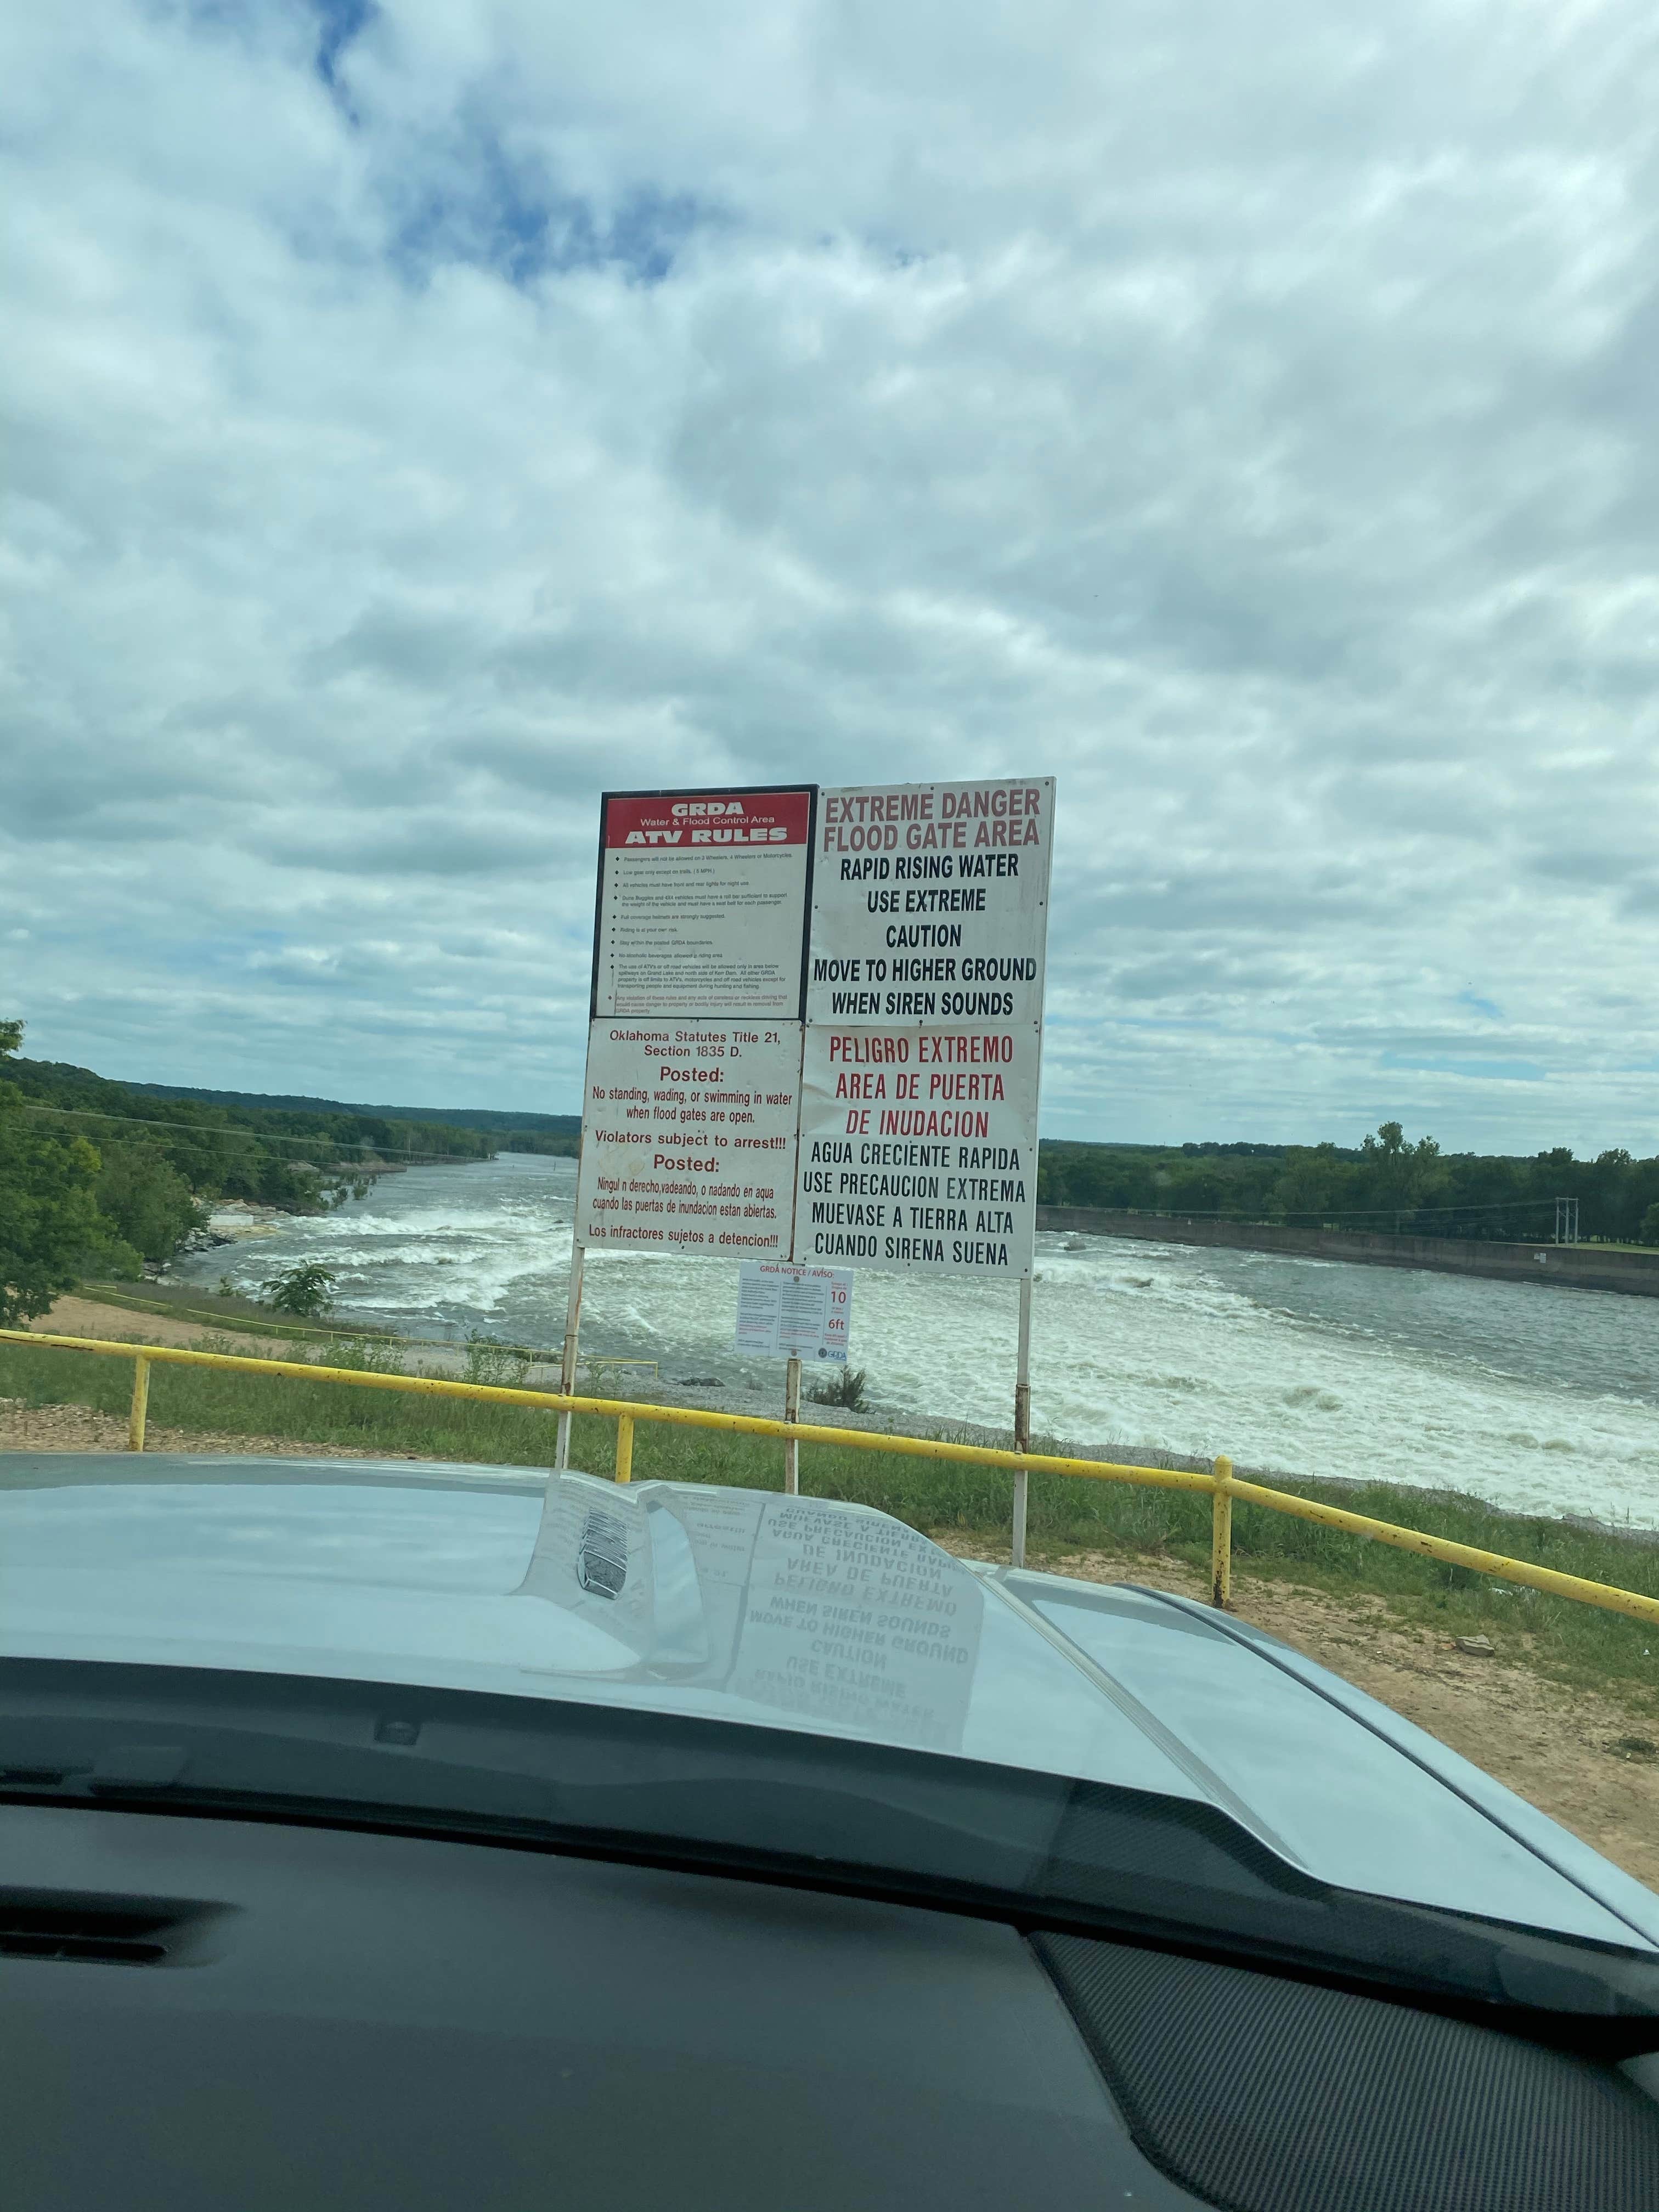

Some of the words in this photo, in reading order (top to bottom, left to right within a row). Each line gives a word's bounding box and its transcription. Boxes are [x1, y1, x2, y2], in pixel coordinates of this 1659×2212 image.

[672, 802, 743, 816] GRDA
[826, 794, 933, 823] EXTREME
[942, 789, 1040, 819] DANGER
[625, 831, 682, 844] ATV
[692, 827, 787, 843] RULES
[824, 825, 898, 852] FLOOD
[906, 822, 967, 850] GATE
[974, 819, 1039, 847] AREA
[841, 858, 889, 880] RAPID
[895, 855, 952, 879] RISING
[959, 854, 1018, 877] WATER
[868, 890, 900, 913] USE
[906, 889, 986, 912] EXTREME
[887, 924, 961, 947] CAUTION
[814, 959, 860, 981] MOVE
[866, 959, 887, 981] TO
[893, 958, 956, 981] HIGHER
[962, 958, 1036, 981] GROUND
[833, 992, 880, 1014] WHEN
[886, 992, 935, 1014] SIREN
[941, 992, 1013, 1015] SOUNDS
[610, 1030, 669, 1041] Oklahoma
[675, 1031, 726, 1042] Statutes
[733, 1032, 758, 1042] Title
[765, 1032, 780, 1045] 21,
[645, 1045, 690, 1056] Section
[696, 1046, 724, 1057] 1835
[731, 1047, 742, 1057] D.
[830, 1036, 909, 1063] PELIGRO
[919, 1036, 1012, 1063] EXTREMO
[661, 1066, 724, 1082] Posted:
[593, 1086, 605, 1099] No
[610, 1087, 649, 1103] standing,
[654, 1088, 686, 1104] wading,
[691, 1092, 700, 1102] or
[704, 1090, 750, 1106] swimming
[754, 1092, 761, 1104] in
[766, 1092, 792, 1105] water
[836, 1073, 885, 1099] AREA
[896, 1074, 919, 1099] DE
[930, 1074, 1004, 1100] PUERTA
[627, 1105, 649, 1119] when
[654, 1106, 676, 1120] flood
[680, 1108, 706, 1123] gates
[710, 1111, 725, 1121] are
[730, 1112, 754, 1125] open.
[846, 1110, 871, 1134] DE
[879, 1110, 989, 1137] INUDACION
[596, 1130, 651, 1143] Violators
[658, 1133, 708, 1147] subject
[715, 1135, 727, 1147] to
[735, 1137, 786, 1149] arrest!!!
[654, 1154, 719, 1172] Posted:
[811, 1142, 852, 1163] AGUA
[861, 1143, 950, 1167] CRECIENTE
[959, 1147, 1019, 1170] RAPIDA
[702, 1186, 706, 1195] o
[709, 1183, 740, 1197] nadando
[744, 1187, 753, 1197] en
[804, 1172, 832, 1193] USE
[840, 1173, 938, 1198] PRECAUCION
[947, 1178, 1025, 1202] EXTREMA
[593, 1197, 619, 1210] cuando
[622, 1198, 632, 1211] las
[635, 1199, 663, 1214] puertas
[667, 1200, 675, 1212] de
[679, 1201, 716, 1215] inundacion
[720, 1204, 741, 1216] estan
[744, 1204, 776, 1218] abiertas.
[812, 1202, 885, 1226] MUEVASE
[893, 1206, 902, 1227] A
[910, 1207, 967, 1231] TIERRA
[976, 1211, 1013, 1233] ALTA
[589, 1224, 606, 1237] Los
[611, 1226, 663, 1240] infractores
[668, 1229, 703, 1244] sujetos
[709, 1234, 714, 1243] a
[719, 1232, 778, 1247] detencion!!!
[815, 1233, 877, 1257] CUANDO
[885, 1237, 944, 1261] SIRENA
[953, 1240, 1008, 1265] SUENA
[831, 1291, 846, 1303] 10
[829, 1319, 844, 1330] 6ft
